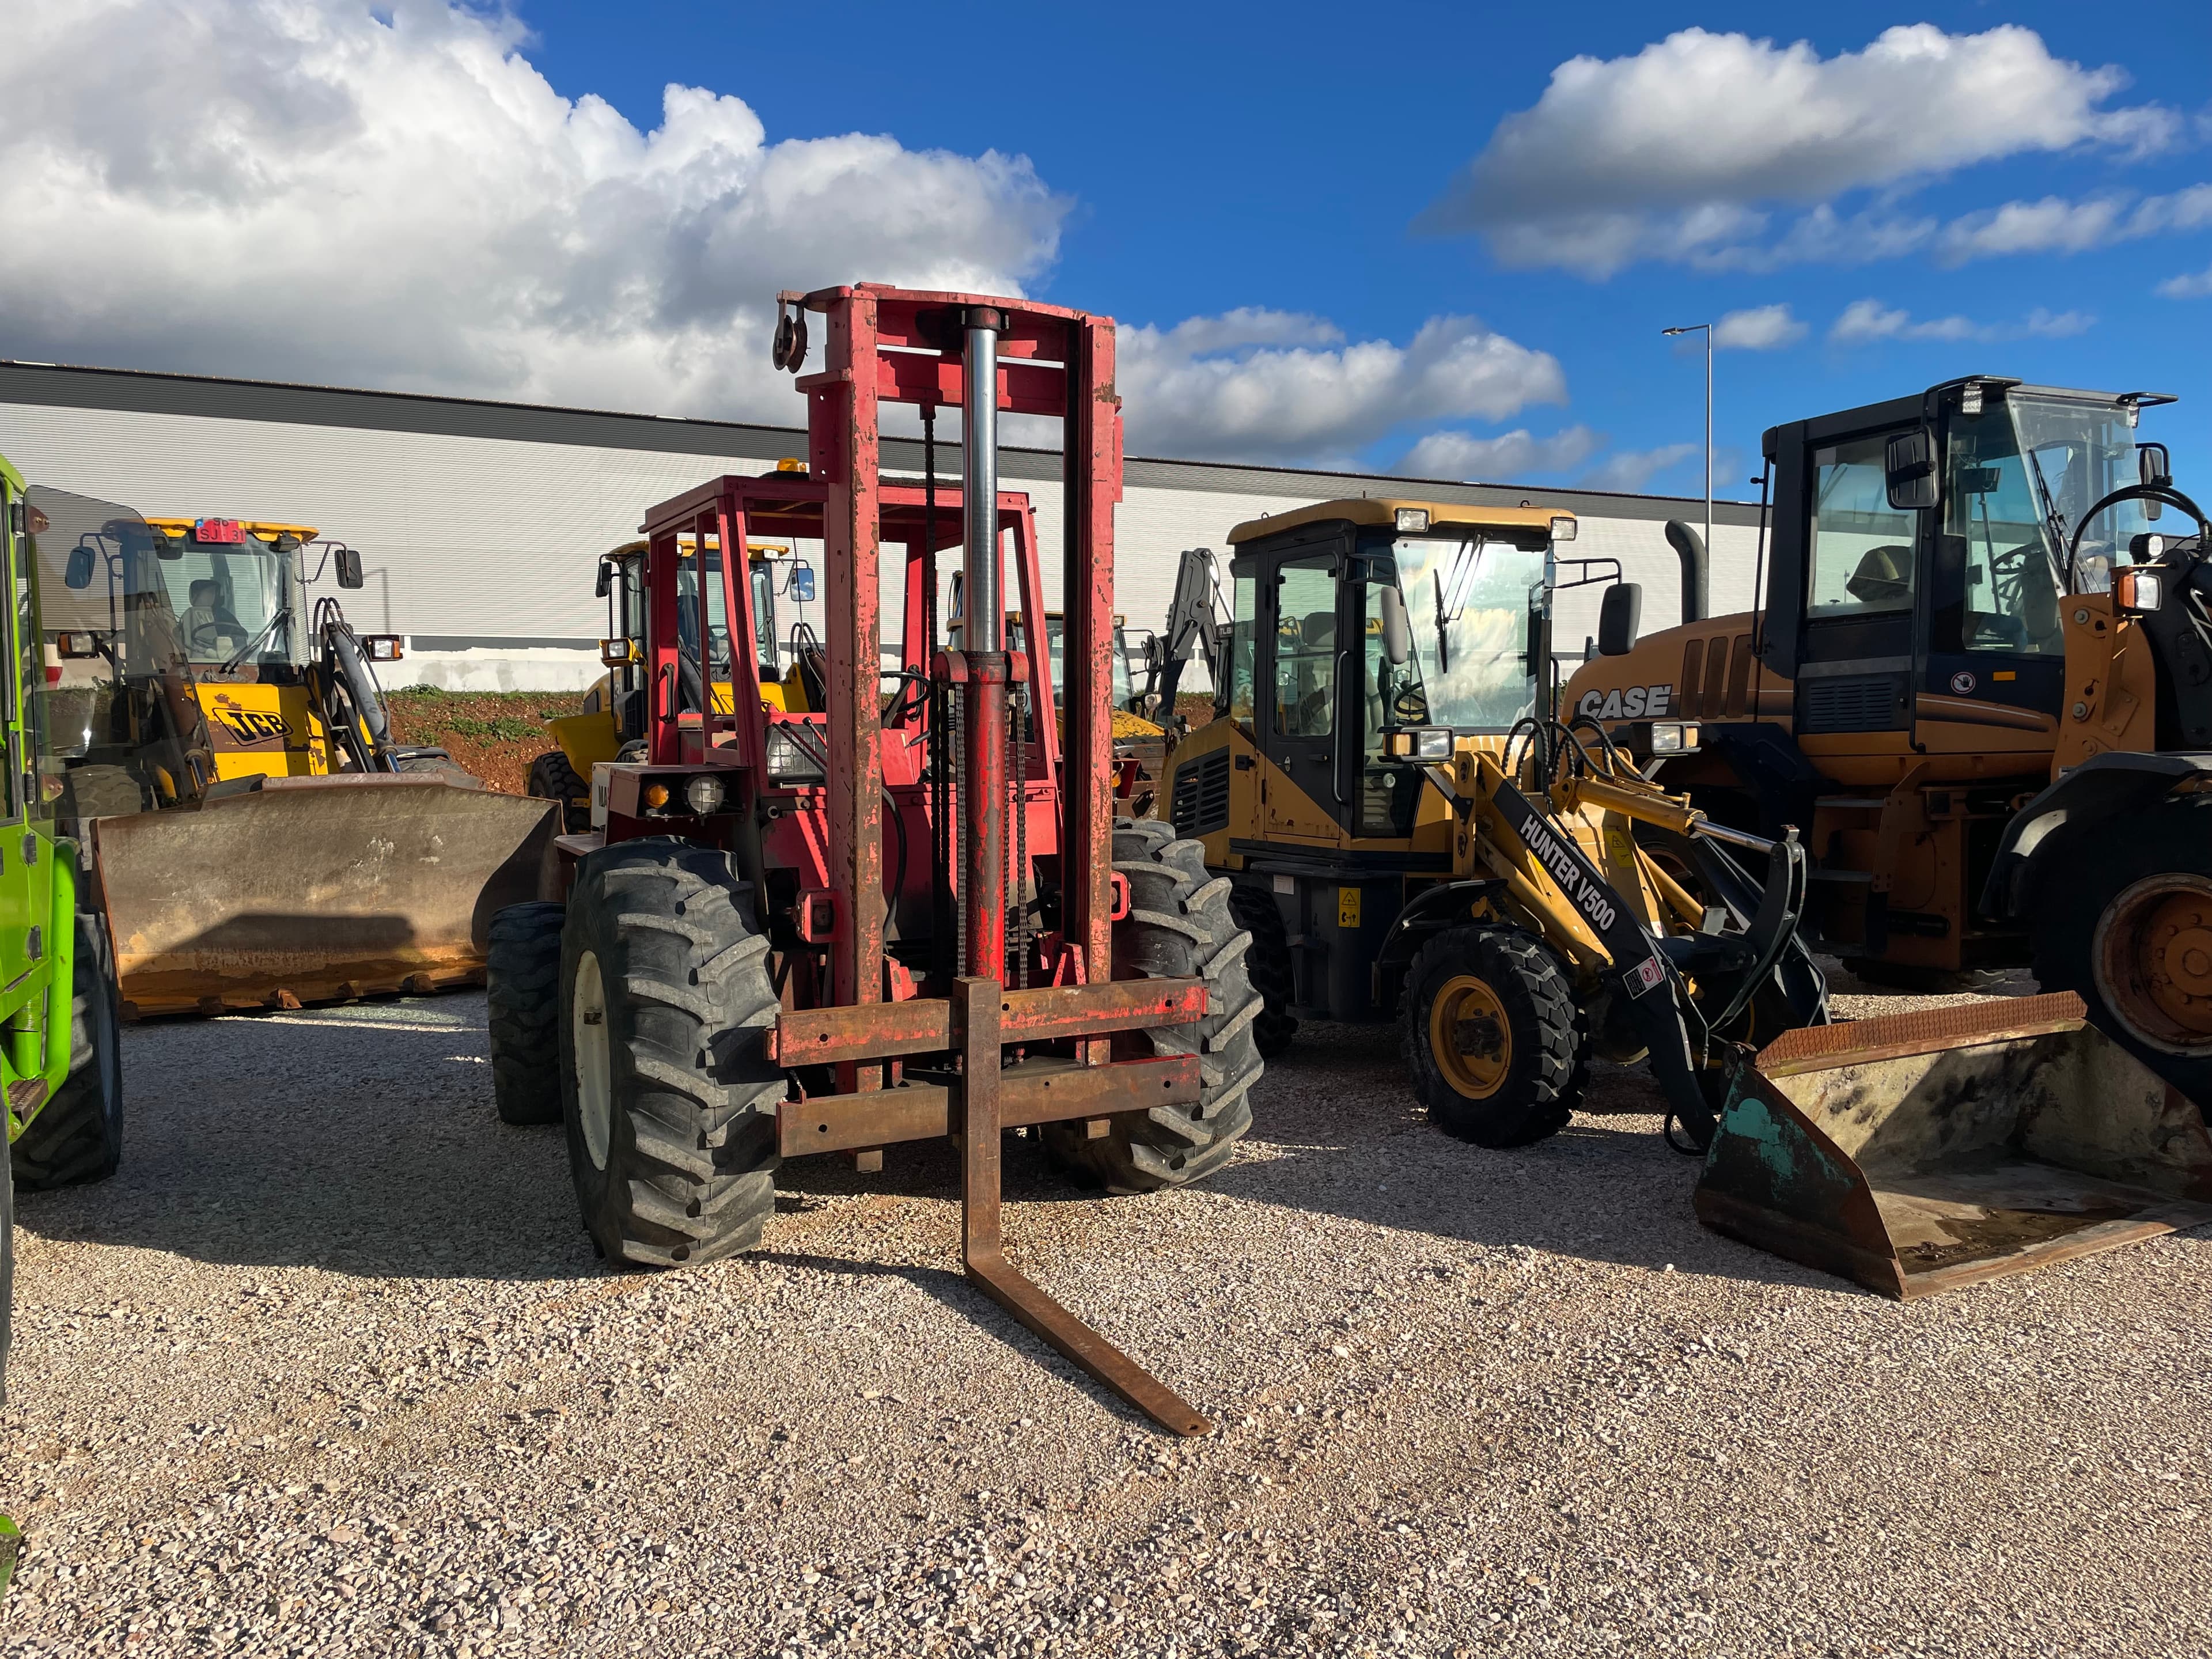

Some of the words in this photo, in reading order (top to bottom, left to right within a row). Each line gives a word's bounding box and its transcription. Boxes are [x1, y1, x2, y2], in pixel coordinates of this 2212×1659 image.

[1219, 627, 1233, 635] TLB
[1580, 685, 1672, 719] CASE
[226, 711, 287, 741] JCB
[1520, 813, 1580, 892] HUNTER
[1576, 877, 1615, 930] V500
